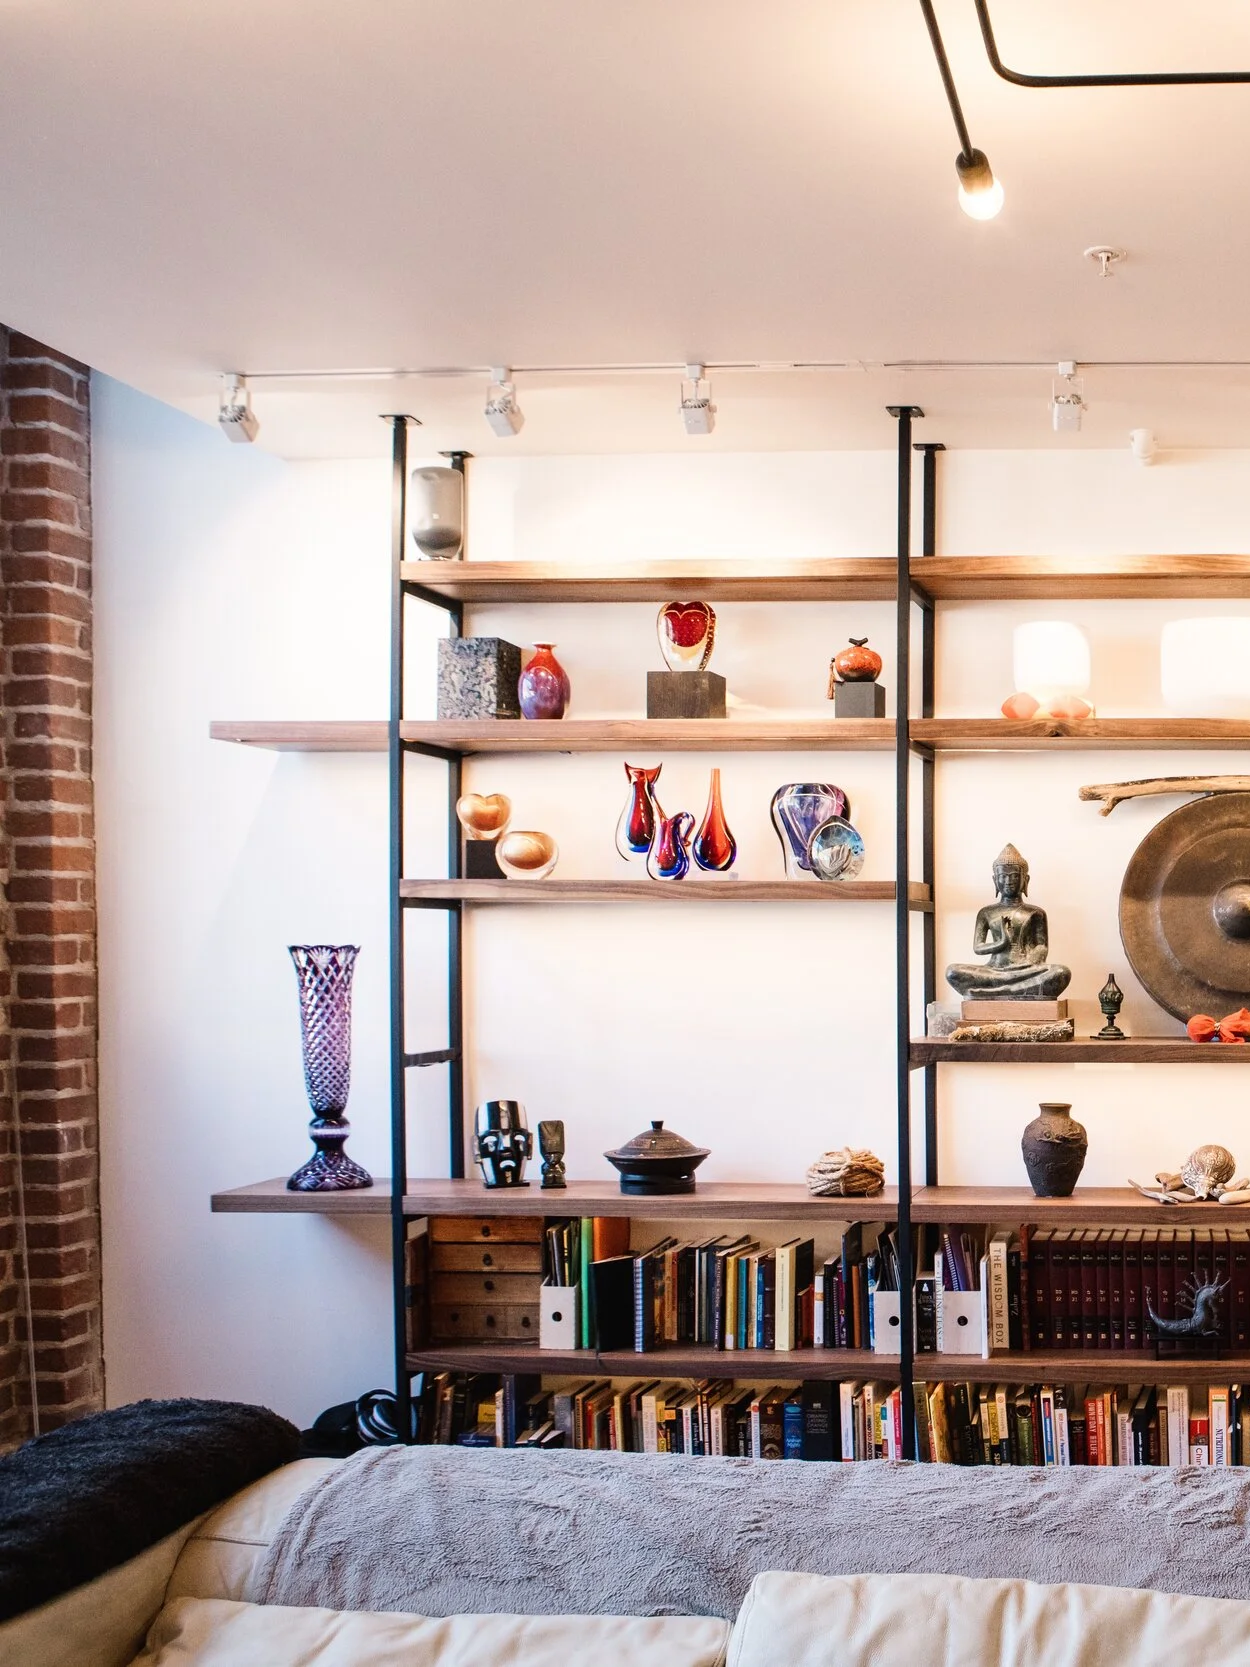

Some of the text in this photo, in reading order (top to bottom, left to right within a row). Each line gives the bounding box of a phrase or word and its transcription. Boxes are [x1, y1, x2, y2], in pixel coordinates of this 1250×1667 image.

[993, 1247, 1004, 1344] THE WISDOM BOX
[1195, 1447, 1203, 1466] Chin
[1216, 1428, 1224, 1466] NUTRITIONAL
